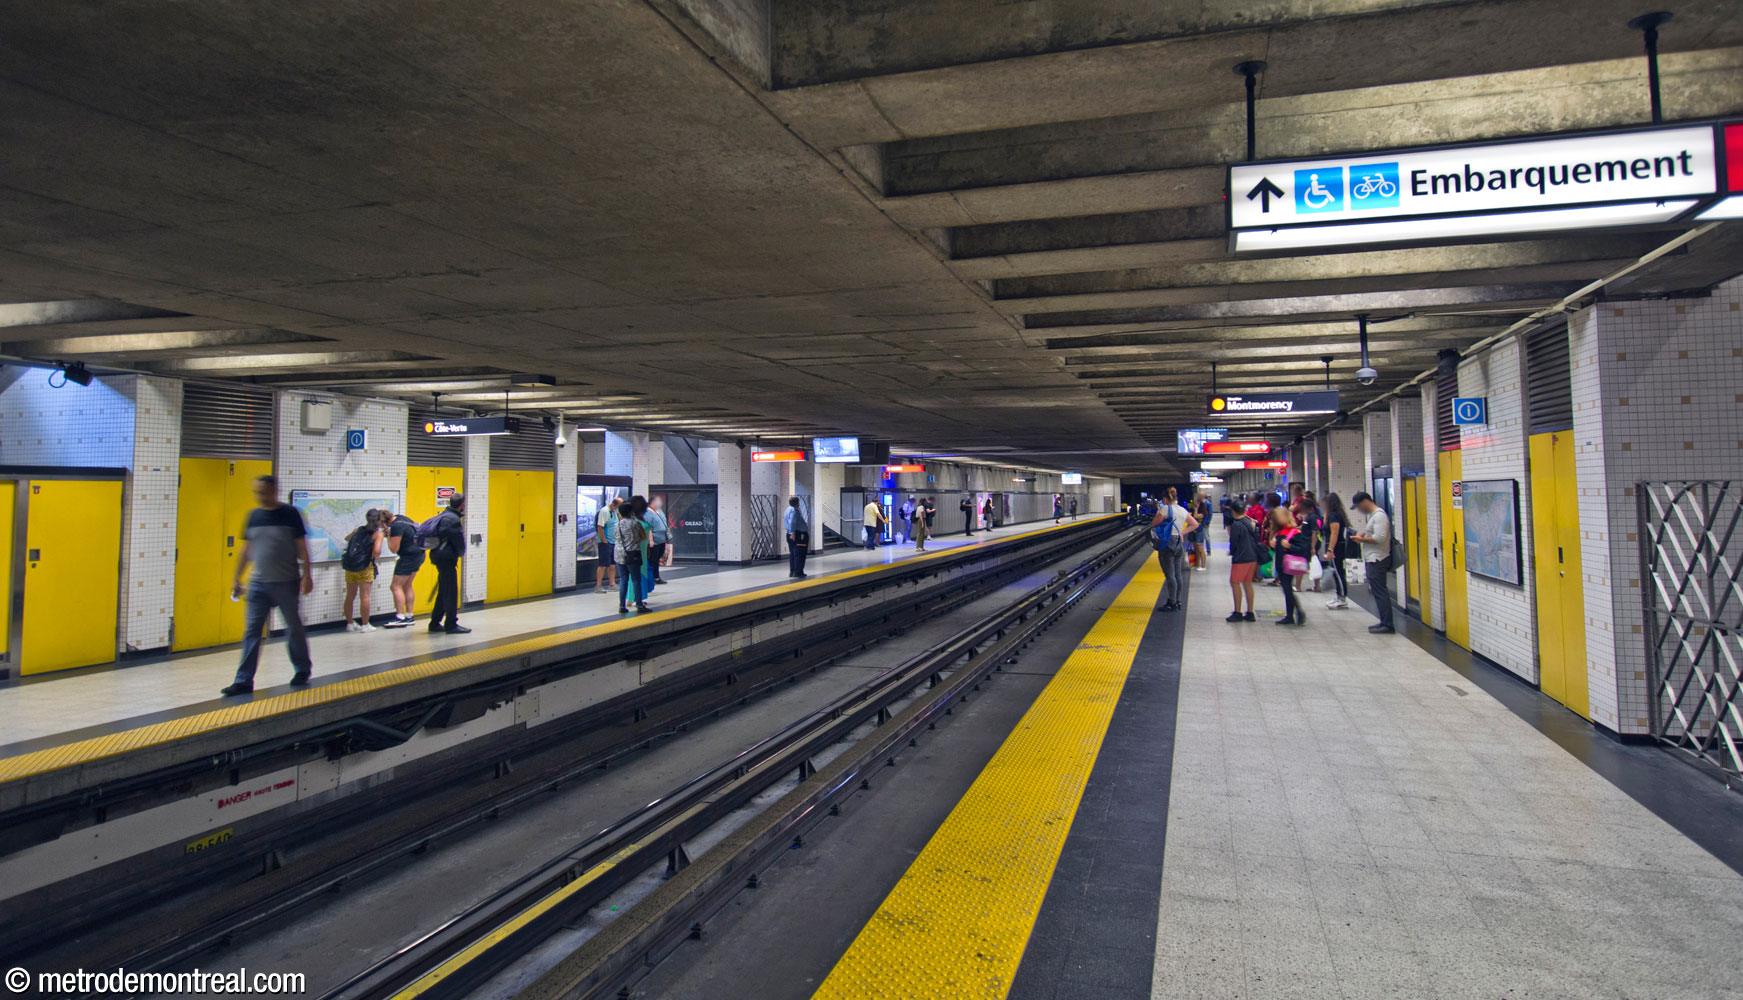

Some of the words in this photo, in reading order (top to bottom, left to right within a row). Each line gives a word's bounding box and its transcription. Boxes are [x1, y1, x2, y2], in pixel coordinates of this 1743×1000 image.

[1410, 149, 1693, 196] Embarquement
[1227, 400, 1293, 412] Montmorency
[218, 791, 251, 808] DANGER
